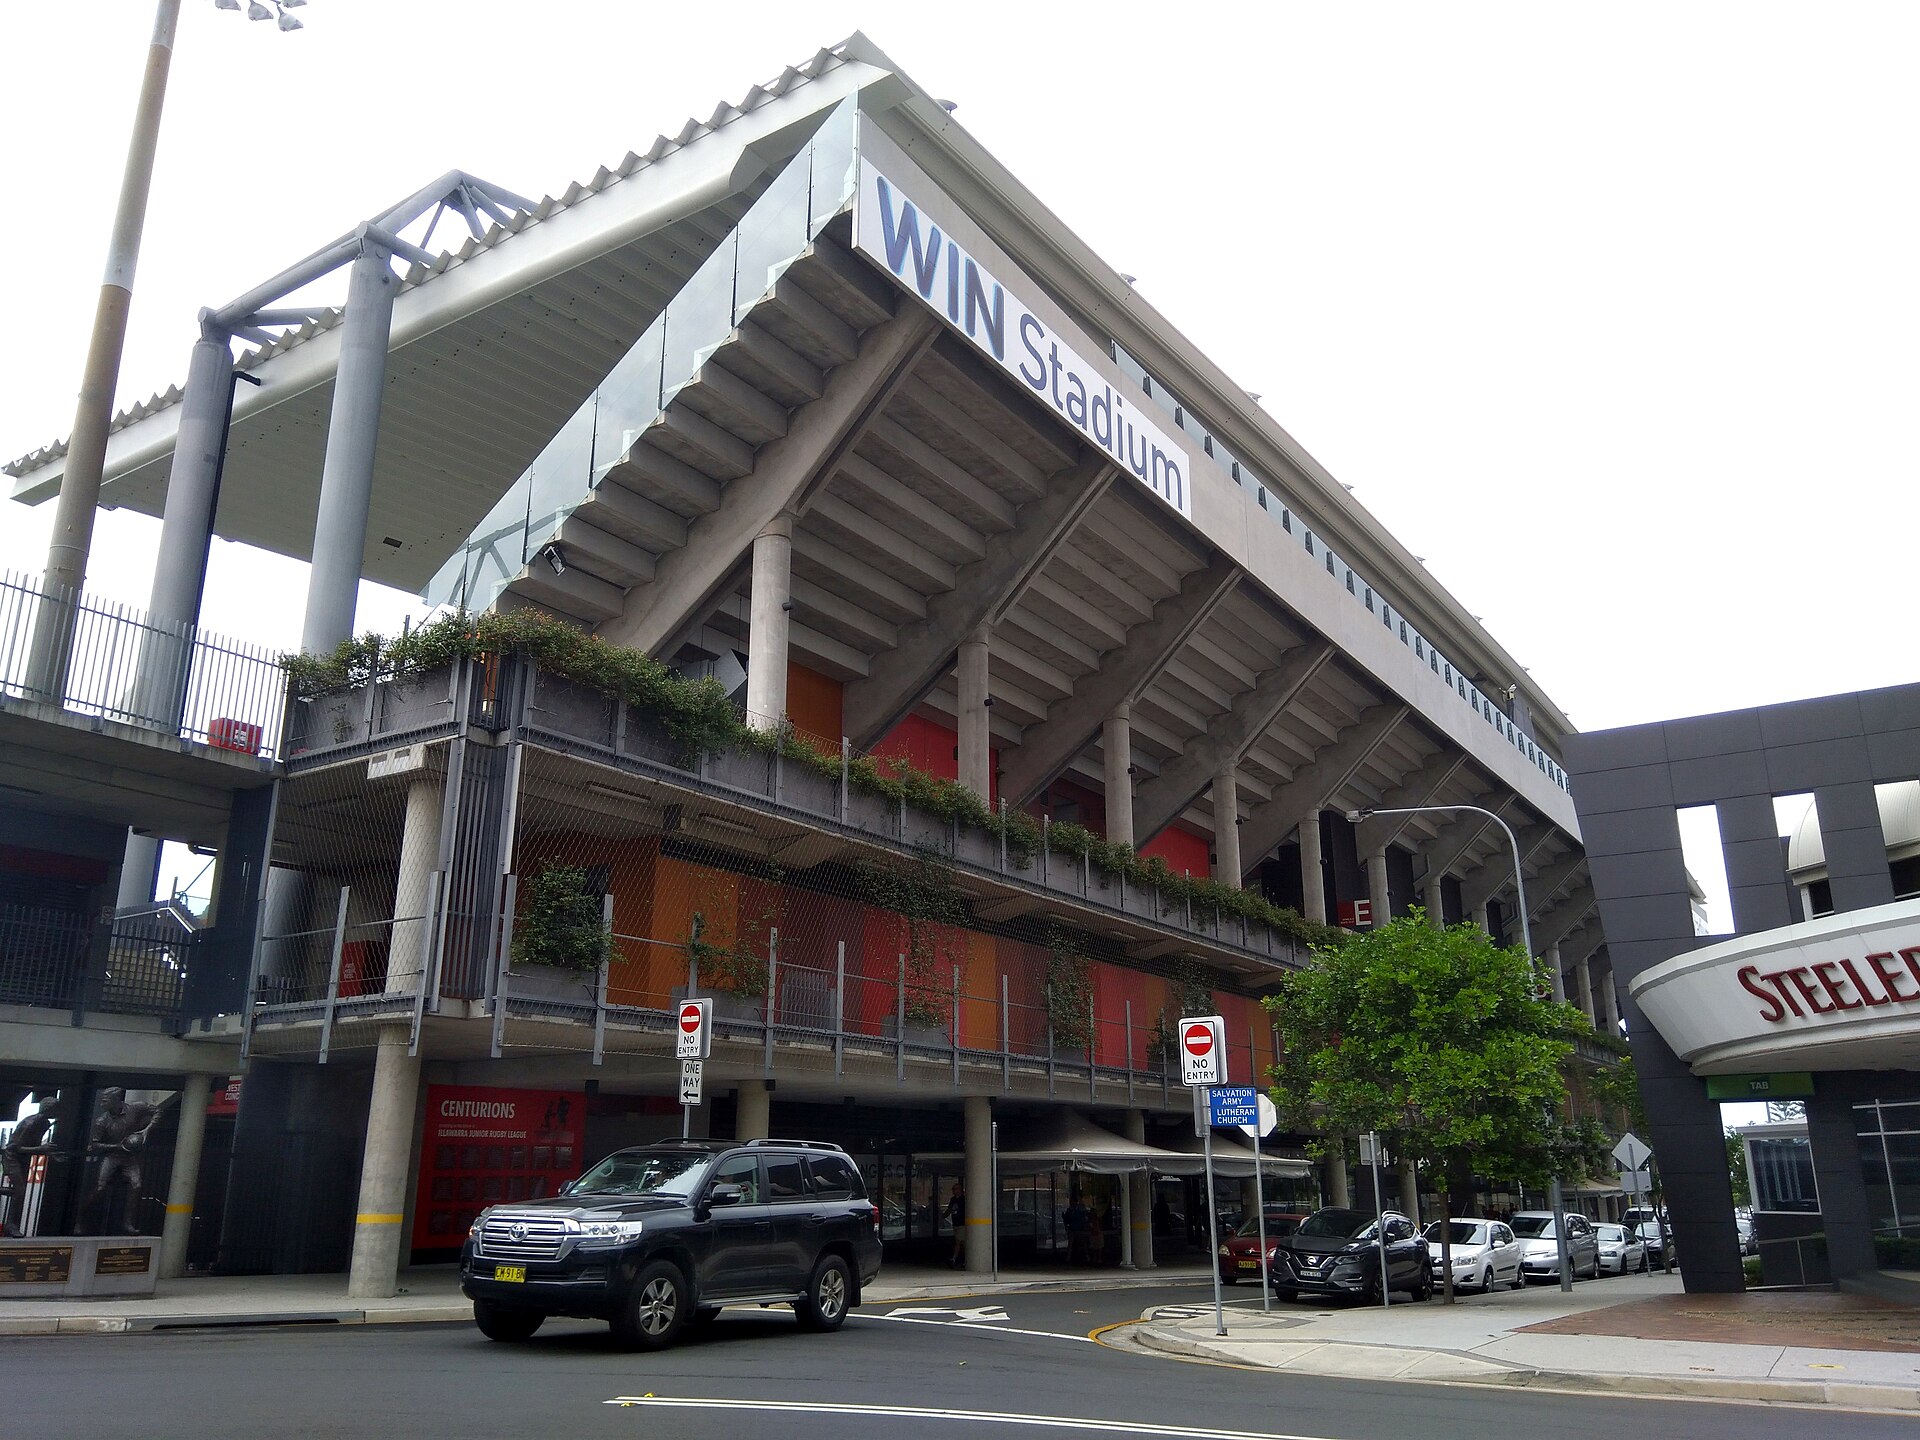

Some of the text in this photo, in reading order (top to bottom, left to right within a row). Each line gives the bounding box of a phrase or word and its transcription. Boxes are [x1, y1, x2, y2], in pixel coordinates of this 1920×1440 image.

[876, 175, 1184, 511] WIN Stadium
[1354, 899, 1371, 926] E
[684, 1036, 695, 1044] NO
[679, 1046, 699, 1054] ENTRY
[685, 1063, 700, 1074] ONE
[1192, 1058, 1208, 1069] NO
[1187, 1070, 1215, 1080] ENTRY
[683, 1077, 700, 1088] WAY
[1750, 1081, 1769, 1090] TAB
[1212, 1089, 1252, 1097] SALVATION
[1222, 1098, 1243, 1106] ARMY
[440, 1099, 516, 1119] CENTURIONS
[1217, 1108, 1255, 1116] LUTHERAN
[1217, 1116, 1248, 1124] CHURCH
[438, 1129, 527, 1140] ILLAWARRA JUNIOR RUGBY LEAGUE
